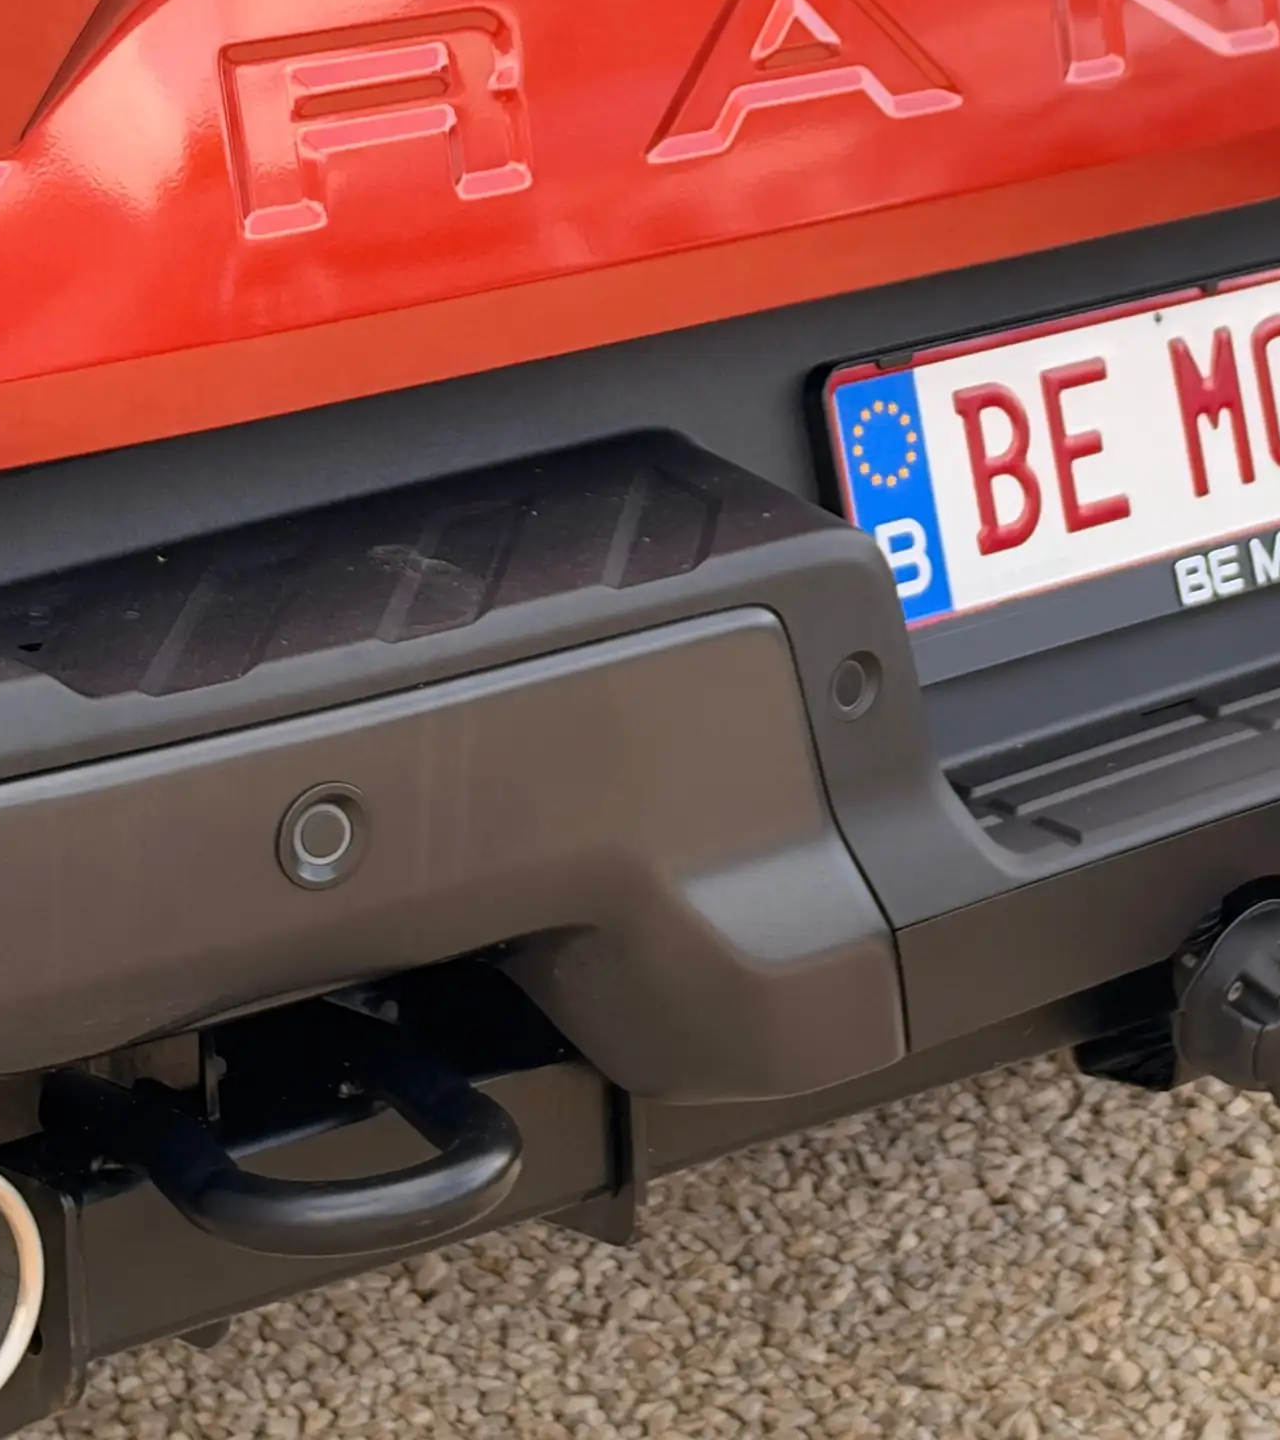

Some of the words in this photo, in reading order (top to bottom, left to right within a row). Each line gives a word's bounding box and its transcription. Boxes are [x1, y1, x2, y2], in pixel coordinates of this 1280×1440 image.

[952, 355, 1132, 556] BE
[875, 517, 932, 598] B
[1175, 544, 1245, 607] BE
